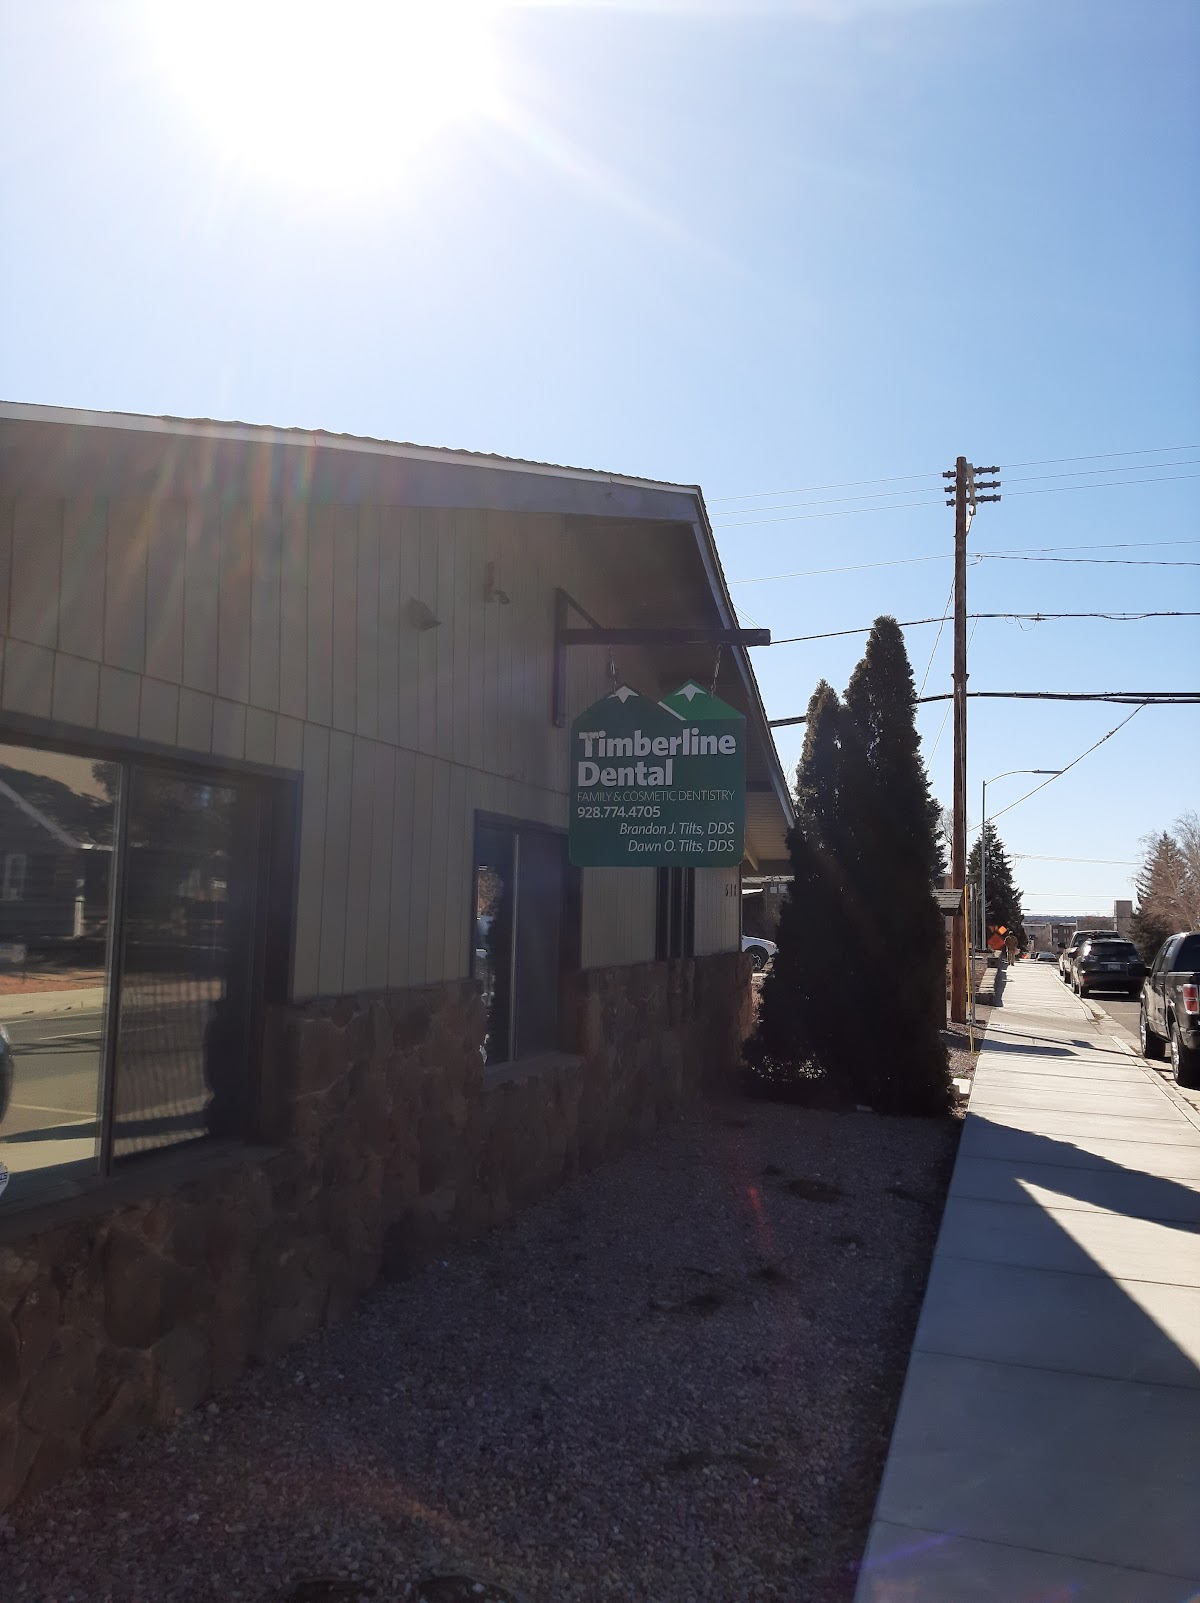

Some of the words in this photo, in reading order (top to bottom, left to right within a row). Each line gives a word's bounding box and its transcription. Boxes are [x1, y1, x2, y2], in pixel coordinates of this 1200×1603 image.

[579, 728, 736, 758] Timberline
[577, 759, 673, 786] Dental
[577, 791, 612, 802] FAMILY
[613, 791, 622, 802] &
[622, 790, 677, 802] COSMETIC
[678, 790, 735, 801] DENTISTRY
[577, 805, 661, 818] 928.774.4705
[619, 822, 666, 835] Brandon
[668, 822, 677, 835] J.
[679, 822, 705, 836] Tilts,
[707, 822, 735, 835] DDS
[628, 839, 661, 852] Dawn
[664, 839, 676, 852] O.
[679, 839, 704, 853] Tilts,
[707, 839, 735, 852] DDS
